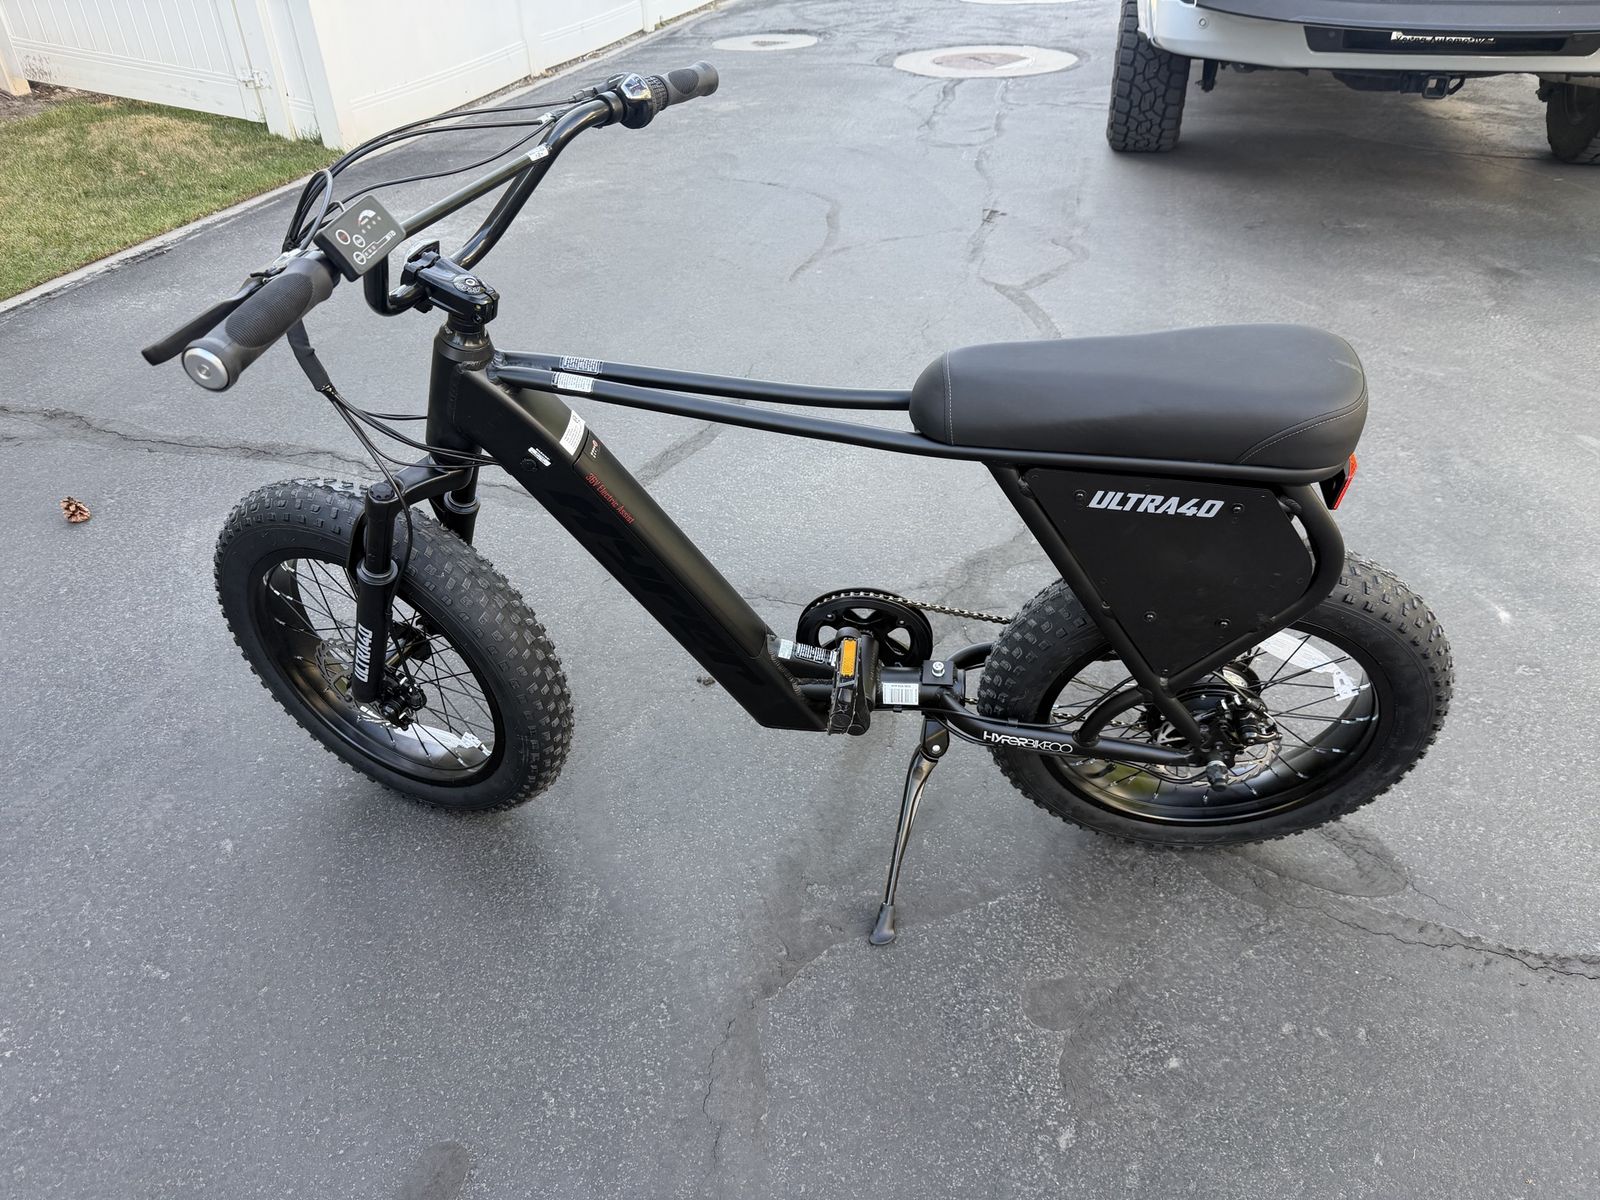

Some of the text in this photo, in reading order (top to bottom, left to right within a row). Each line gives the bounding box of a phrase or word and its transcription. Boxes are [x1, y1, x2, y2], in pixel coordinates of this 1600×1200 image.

[598, 484, 618, 508] Electric
[617, 505, 635, 523] Assist
[1087, 490, 1225, 518] ULTRA40
[354, 622, 373, 683] ULTRA40
